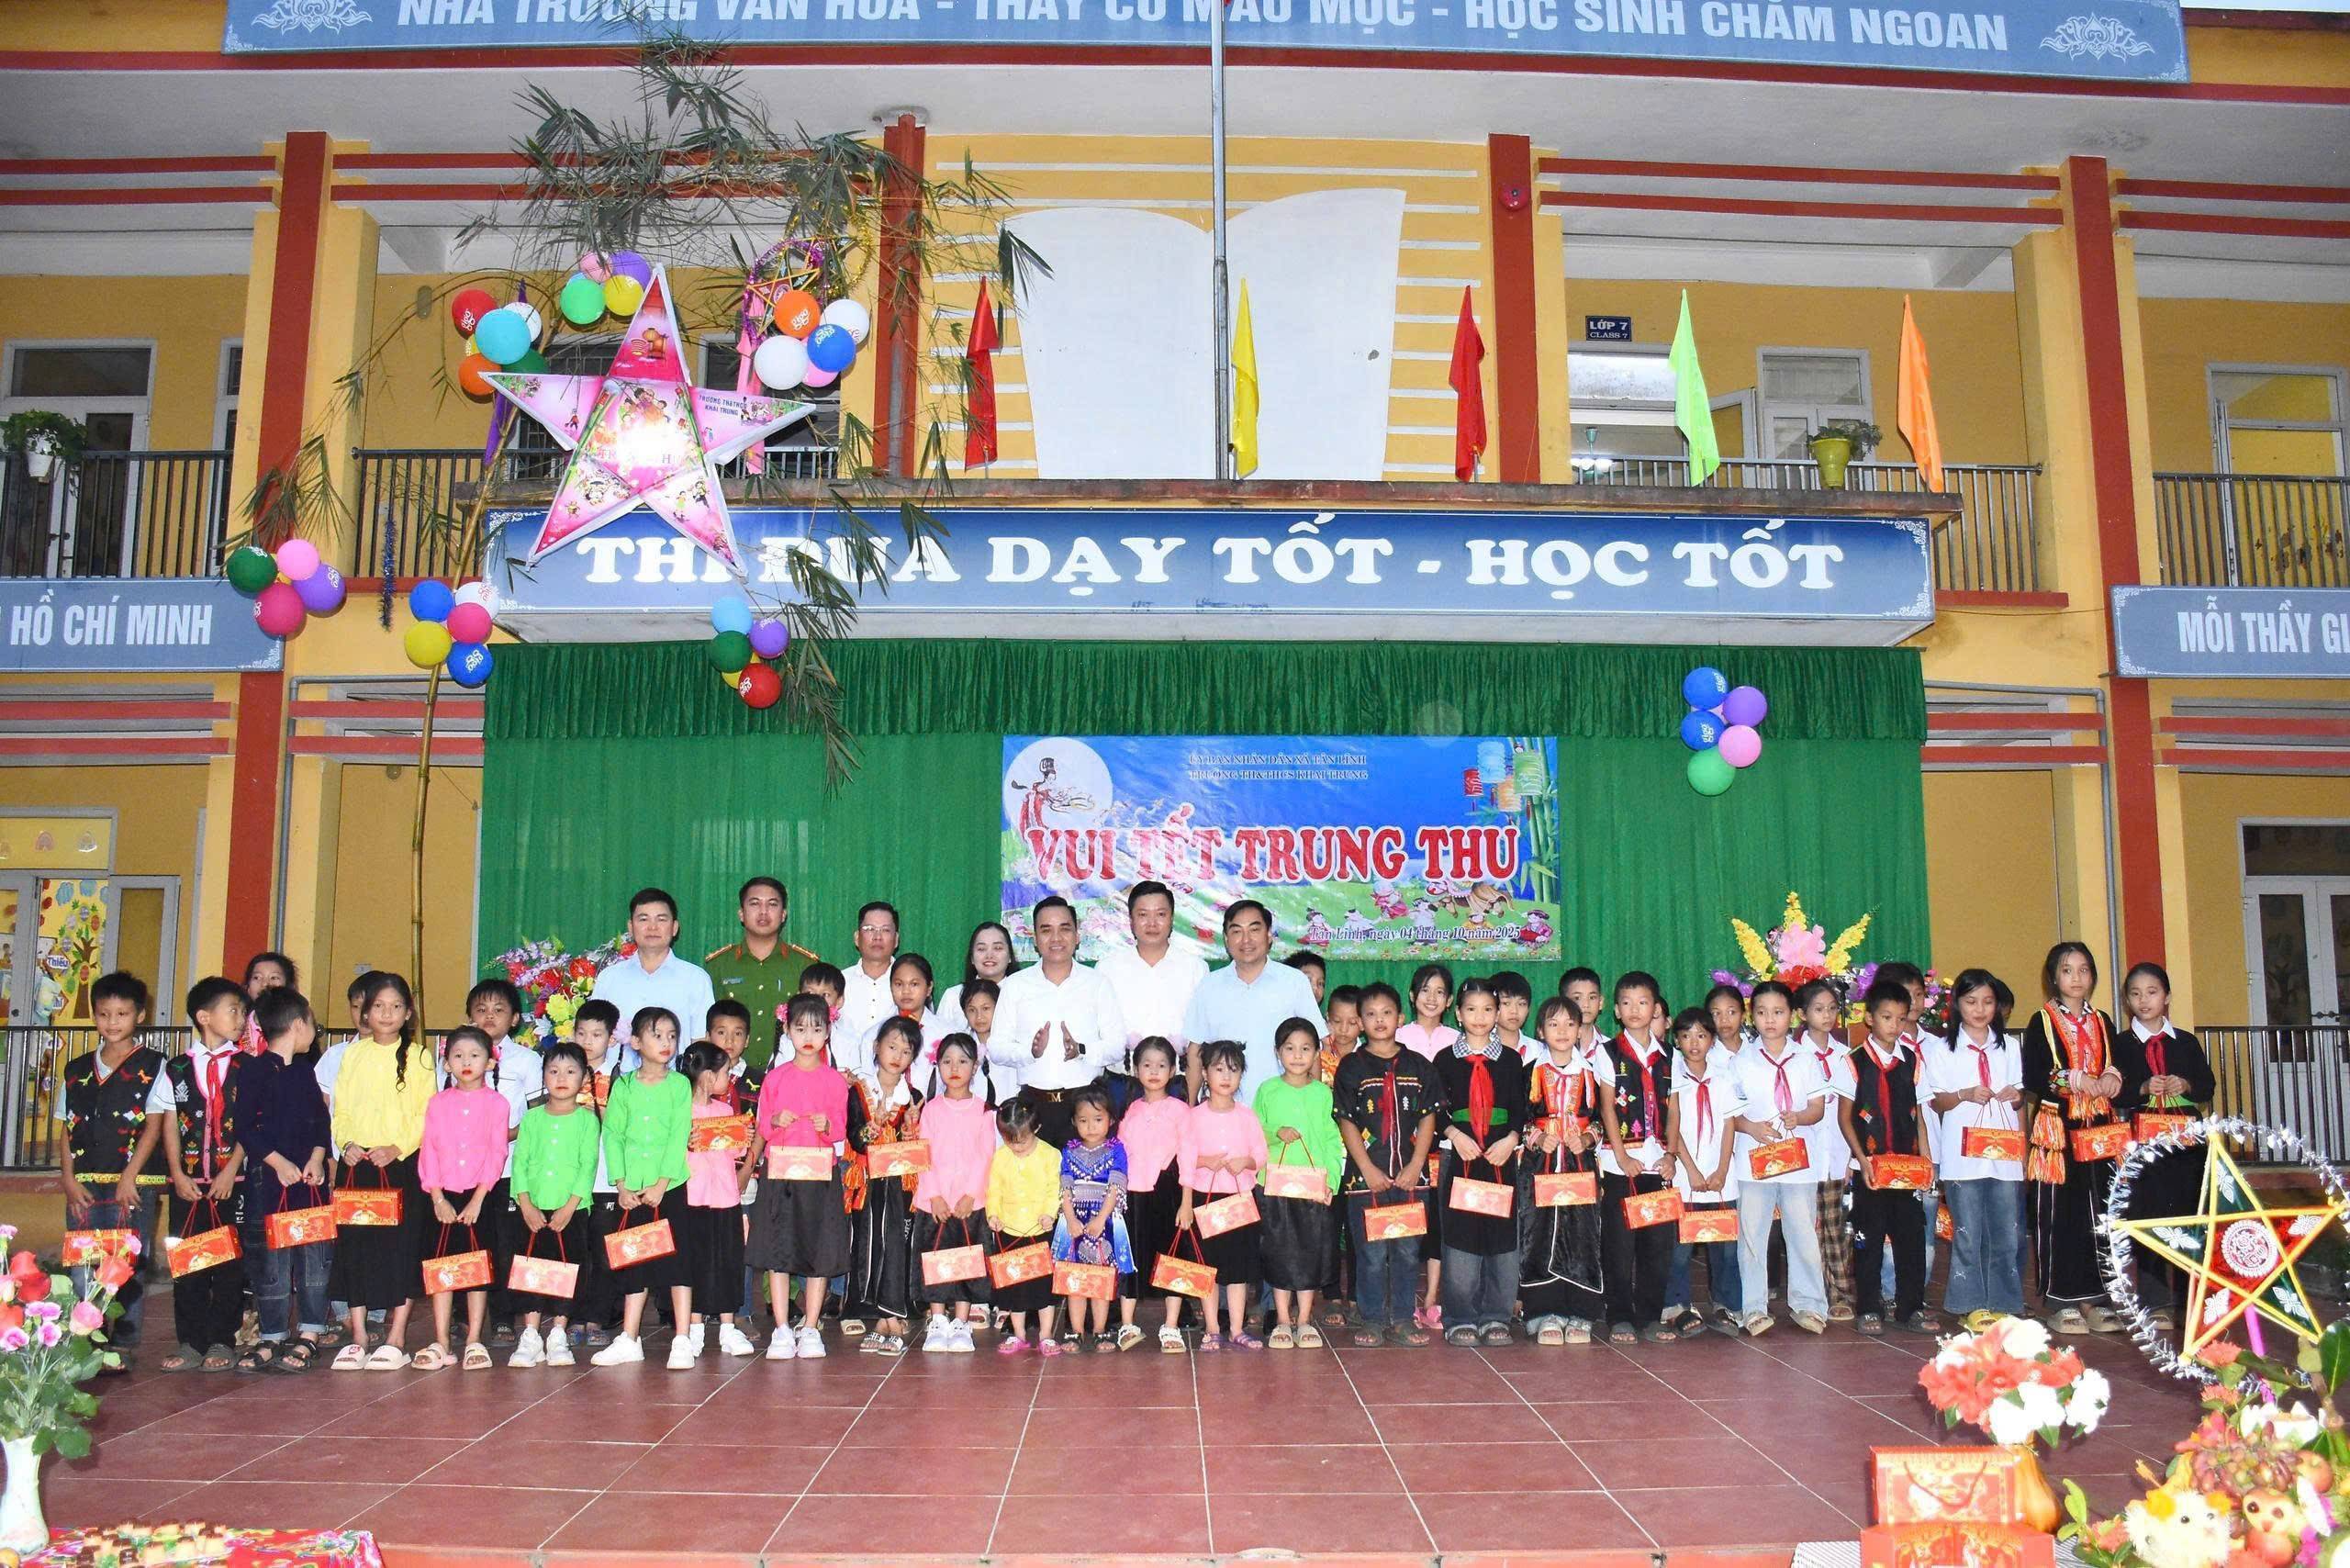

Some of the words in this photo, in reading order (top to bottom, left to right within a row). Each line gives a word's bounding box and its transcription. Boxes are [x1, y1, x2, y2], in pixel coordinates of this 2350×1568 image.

[1465, 0, 1559, 39] HỌC
[1574, 1, 1686, 35] SINH
[1849, 8, 2008, 50] NGOAN
[1590, 319, 1616, 330] LỚP
[1619, 322, 1628, 330] 7
[985, 536, 1187, 597] DẠY
[1212, 512, 1394, 585] TỐT
[1465, 539, 1650, 600] HỌC
[1672, 519, 1844, 590] TỐT
[10, 588, 54, 645] HỒ
[63, 595, 120, 645] CHÍ
[127, 605, 213, 645] MINH
[2177, 595, 2234, 653] MỖI
[2241, 599, 2311, 653] THẦY
[1240, 770, 1294, 779] TH&THCS
[1297, 770, 1326, 779] KHAI
[1328, 770, 1369, 780] TRUNG
[1025, 827, 1117, 880] VUI
[1128, 804, 1225, 880] TẾT
[1234, 828, 1405, 880] TRUNG
[1417, 828, 1518, 879] THU
[1369, 927, 1395, 942] ngày
[1399, 926, 1413, 938] 04
[1416, 926, 1449, 942] tháng
[1452, 926, 1465, 939] 10
[1495, 925, 1521, 939] 2025
